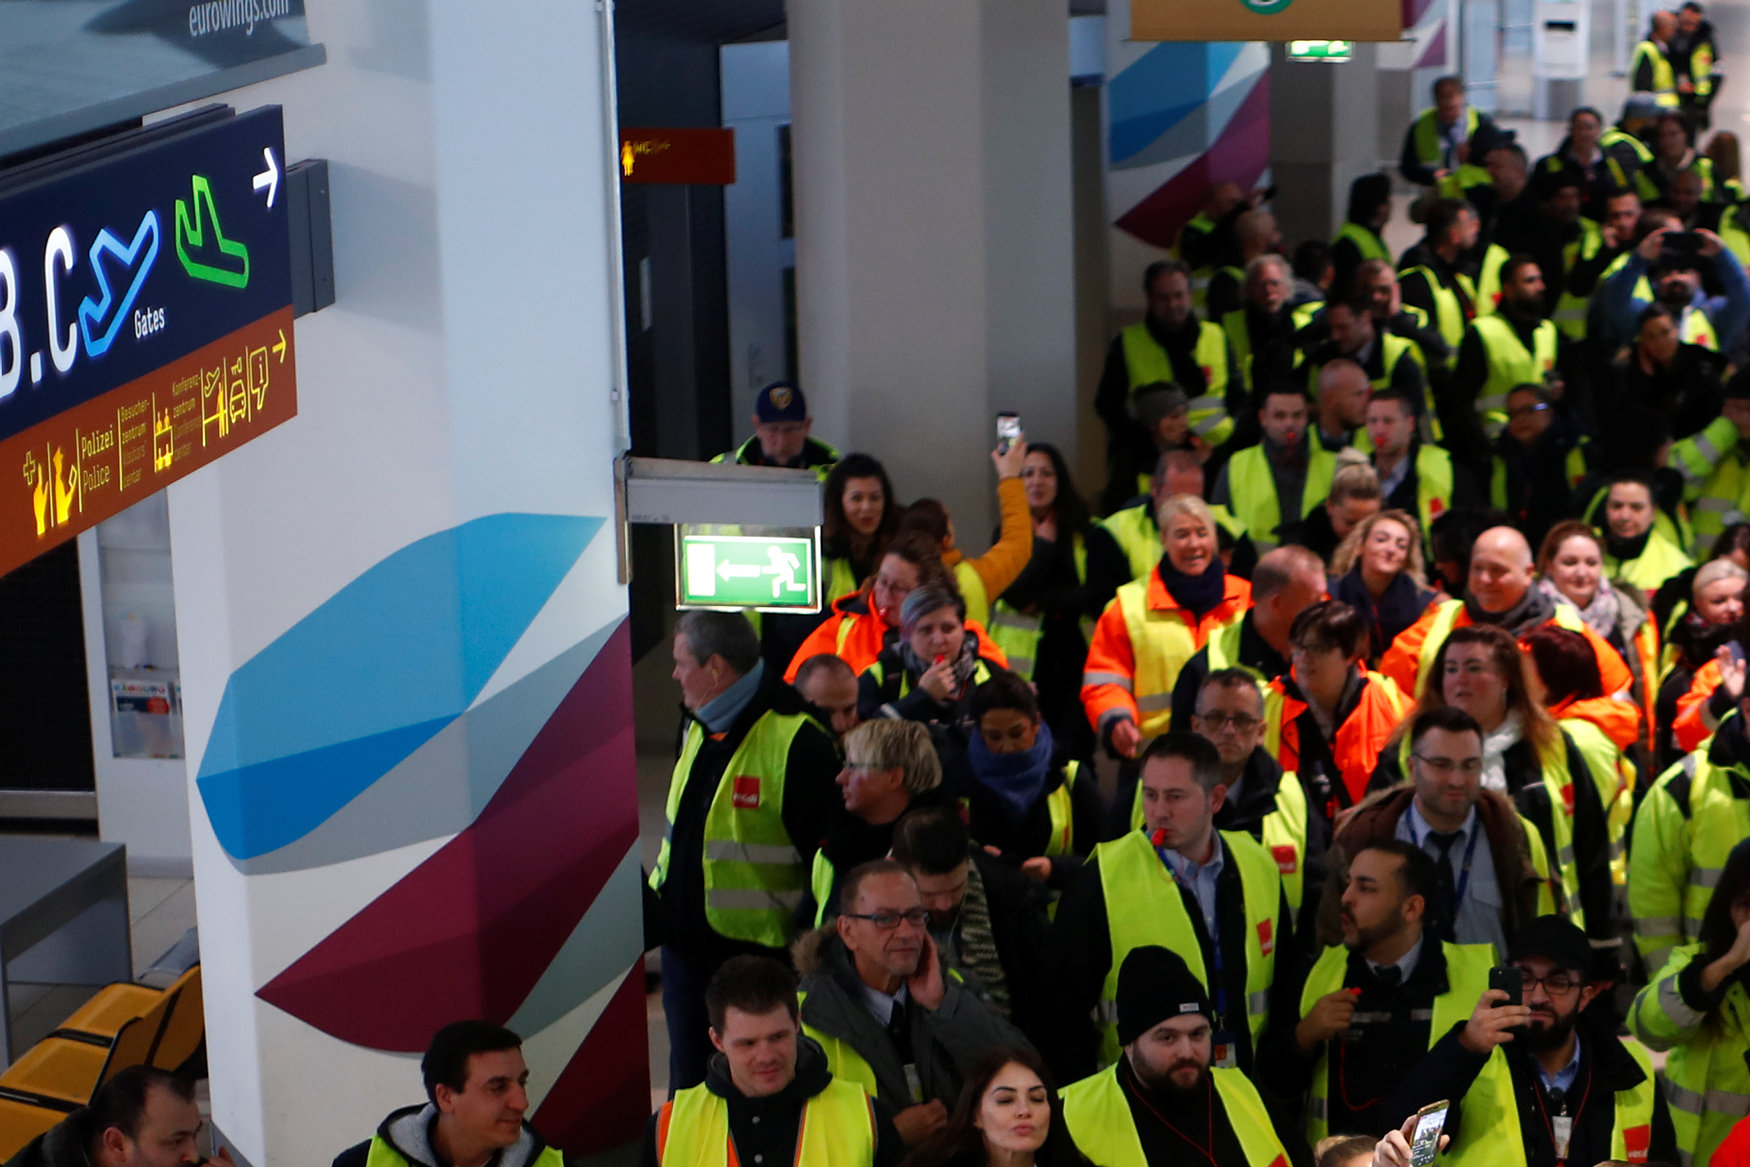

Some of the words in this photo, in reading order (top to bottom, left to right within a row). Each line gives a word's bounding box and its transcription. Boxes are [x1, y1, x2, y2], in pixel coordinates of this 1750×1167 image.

[189, 0, 289, 36] eurowings.com
[134, 307, 165, 339] Gates
[173, 397, 196, 419] zentrum
[81, 424, 114, 460] Polizei
[121, 422, 147, 445] zentrum
[83, 464, 110, 493] Police
